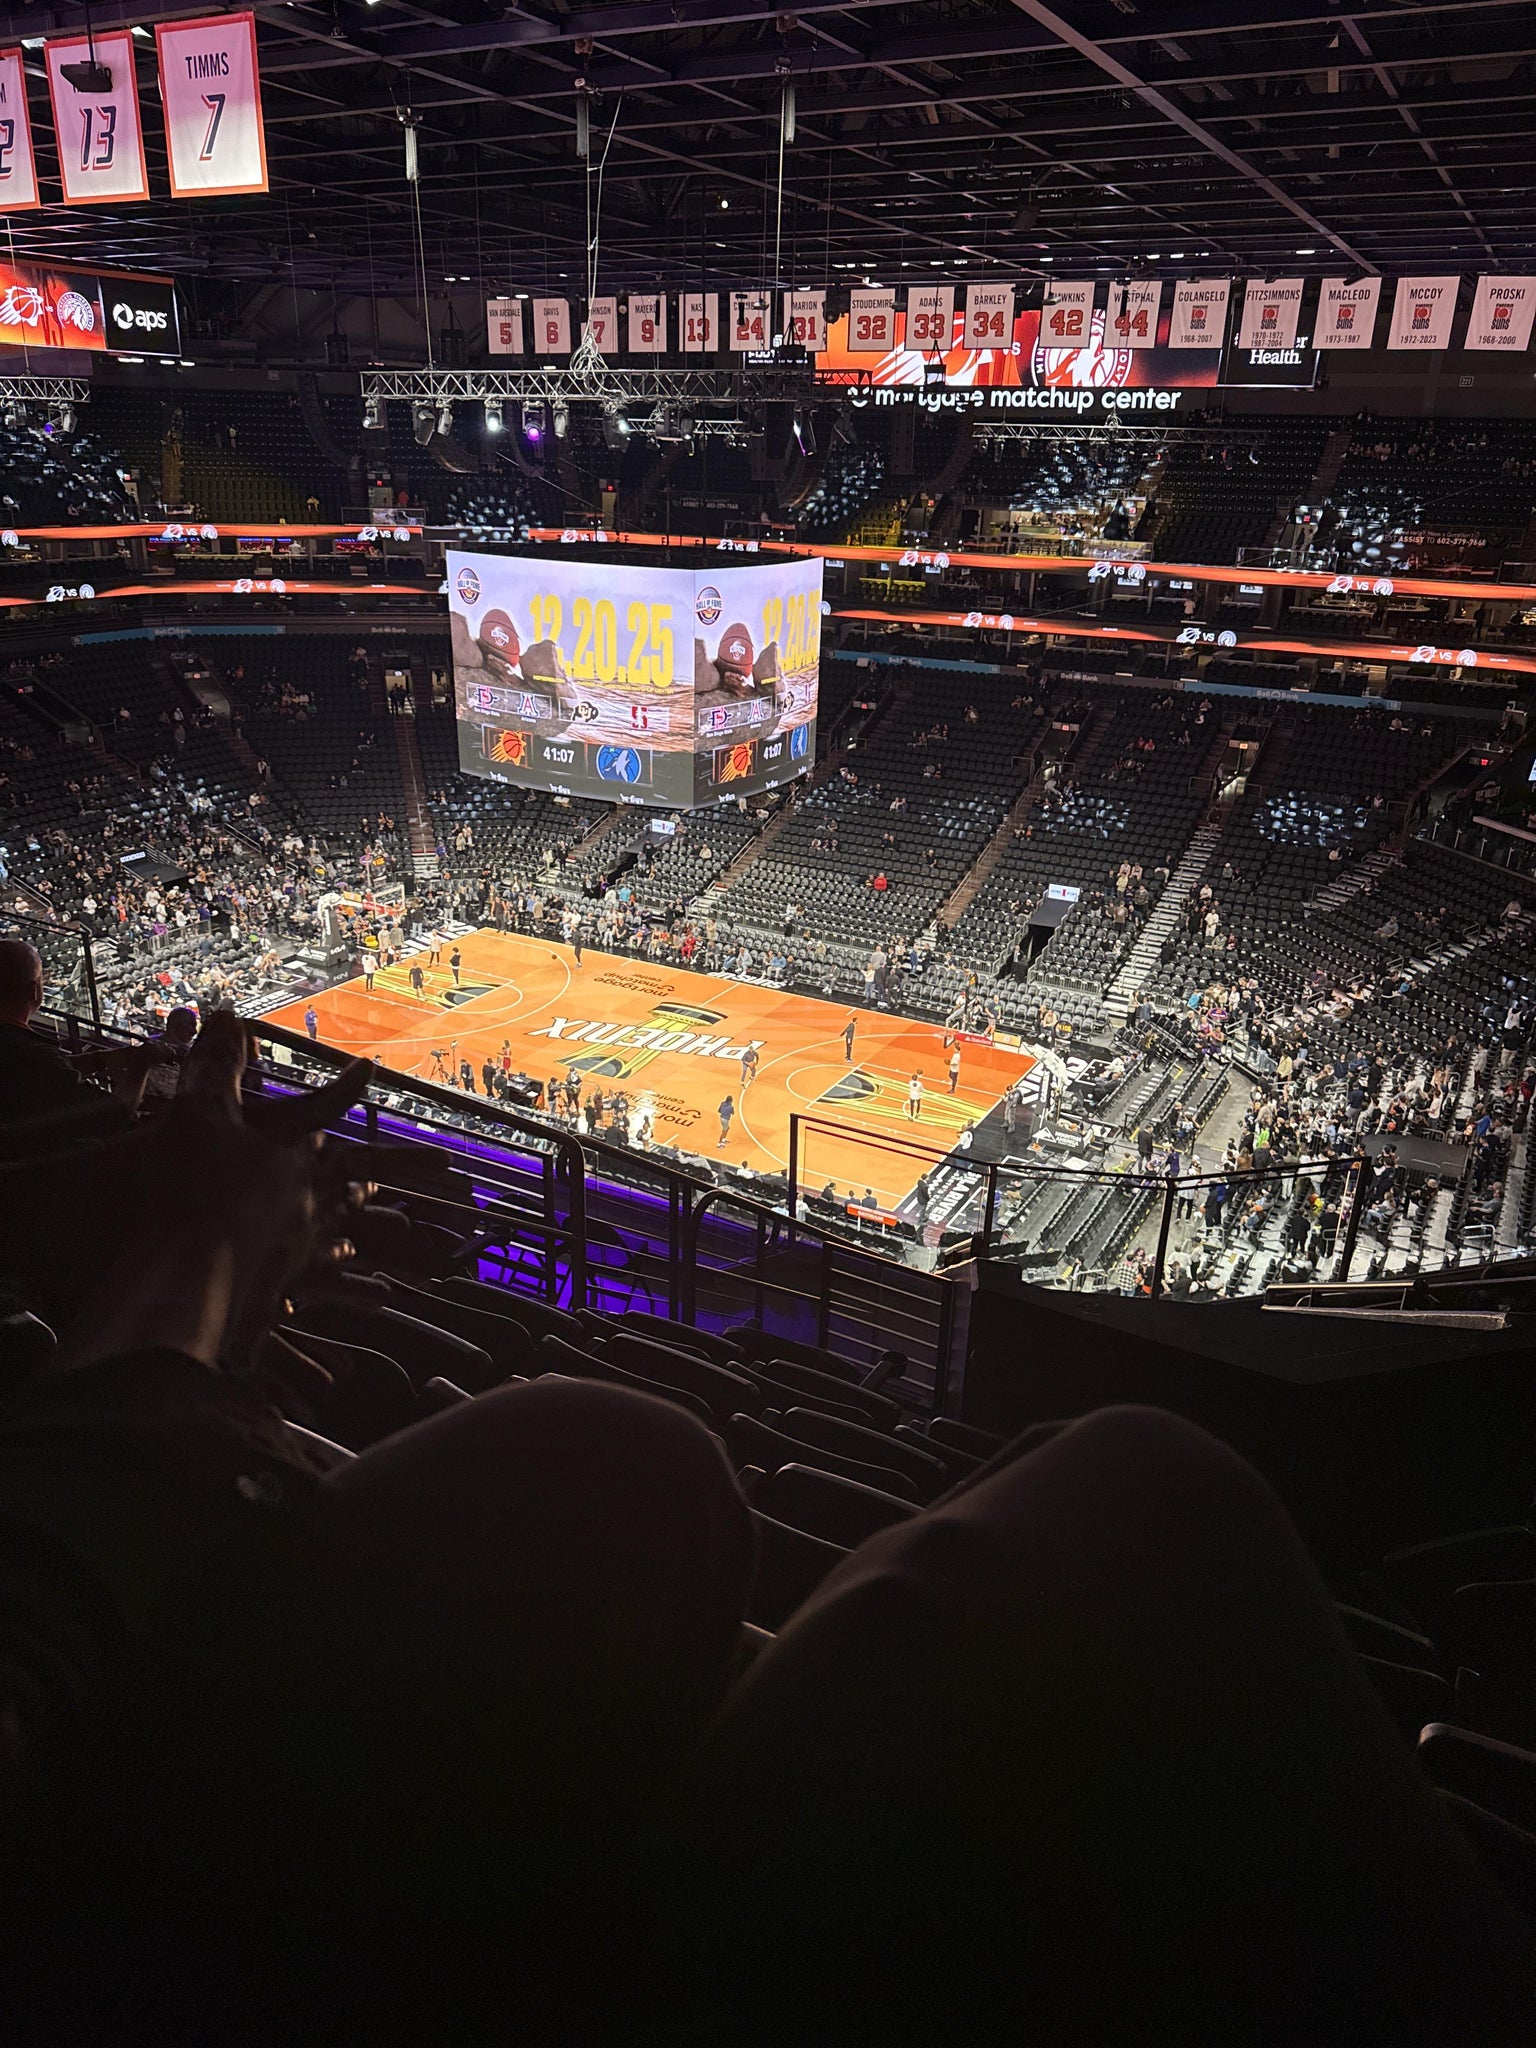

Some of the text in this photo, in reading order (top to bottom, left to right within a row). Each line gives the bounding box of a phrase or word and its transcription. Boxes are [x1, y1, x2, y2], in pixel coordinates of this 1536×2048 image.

[185, 51, 229, 79] TIMMS
[199, 94, 226, 162] 7
[80, 105, 117, 171] 13
[974, 294, 1007, 305] BARKLEY
[1114, 293, 1155, 303] WSTPHAL
[1178, 291, 1225, 302] COLANGELO
[1246, 289, 1300, 301] FITZSIMMONS
[1328, 289, 1370, 301] MACLEOD
[1409, 288, 1443, 300] MCCOY
[1489, 288, 1525, 300] PROSKI
[691, 303, 705, 312] NAS
[792, 301, 817, 310] MARION
[852, 299, 893, 309] STOUDEMIRE
[919, 297, 943, 307] ADAMS
[489, 308, 499, 317] VAN
[543, 307, 559, 316] DAVIS
[590, 306, 611, 315] HNSON
[635, 304, 656, 313] MAJER
[135, 310, 168, 332] aps
[914, 314, 944, 339] 33
[973, 311, 1004, 337] 34
[1050, 309, 1083, 336] 42
[1115, 309, 1148, 337] 44
[500, 322, 512, 344] 5
[546, 321, 558, 344] 6
[593, 321, 605, 343] 7
[641, 319, 654, 342] 9
[688, 318, 710, 341] 13
[737, 317, 764, 340] 24
[793, 316, 816, 341] 31
[857, 315, 886, 340] 32
[1180, 335, 1213, 343] 1968-2007
[1251, 331, 1283, 339] 1970-1972
[1325, 335, 1360, 343] 1973-1987
[1400, 335, 1437, 344] 1972-2023
[1478, 335, 1517, 344] 1968-2000
[991, 389, 1093, 414] matchup
[1101, 388, 1182, 409] center
[186, 528, 197, 536] VS
[380, 530, 391, 538] VS
[1398, 536, 1425, 544] ASSIST
[921, 556, 931, 564] VS
[1113, 566, 1125, 575] VS
[255, 582, 267, 590] VS
[1356, 581, 1369, 591] VS
[66, 588, 77, 597] VS
[985, 616, 995, 625] VS
[529, 593, 674, 688] 12.20.25
[1202, 632, 1215, 642] VS
[1439, 652, 1453, 661] VS
[543, 746, 575, 764] 41:07
[763, 742, 783, 760] 41:07
[604, 972, 659, 987] matchup
[594, 977, 669, 997] mortgage
[526, 1016, 768, 1060] PHOENIX
